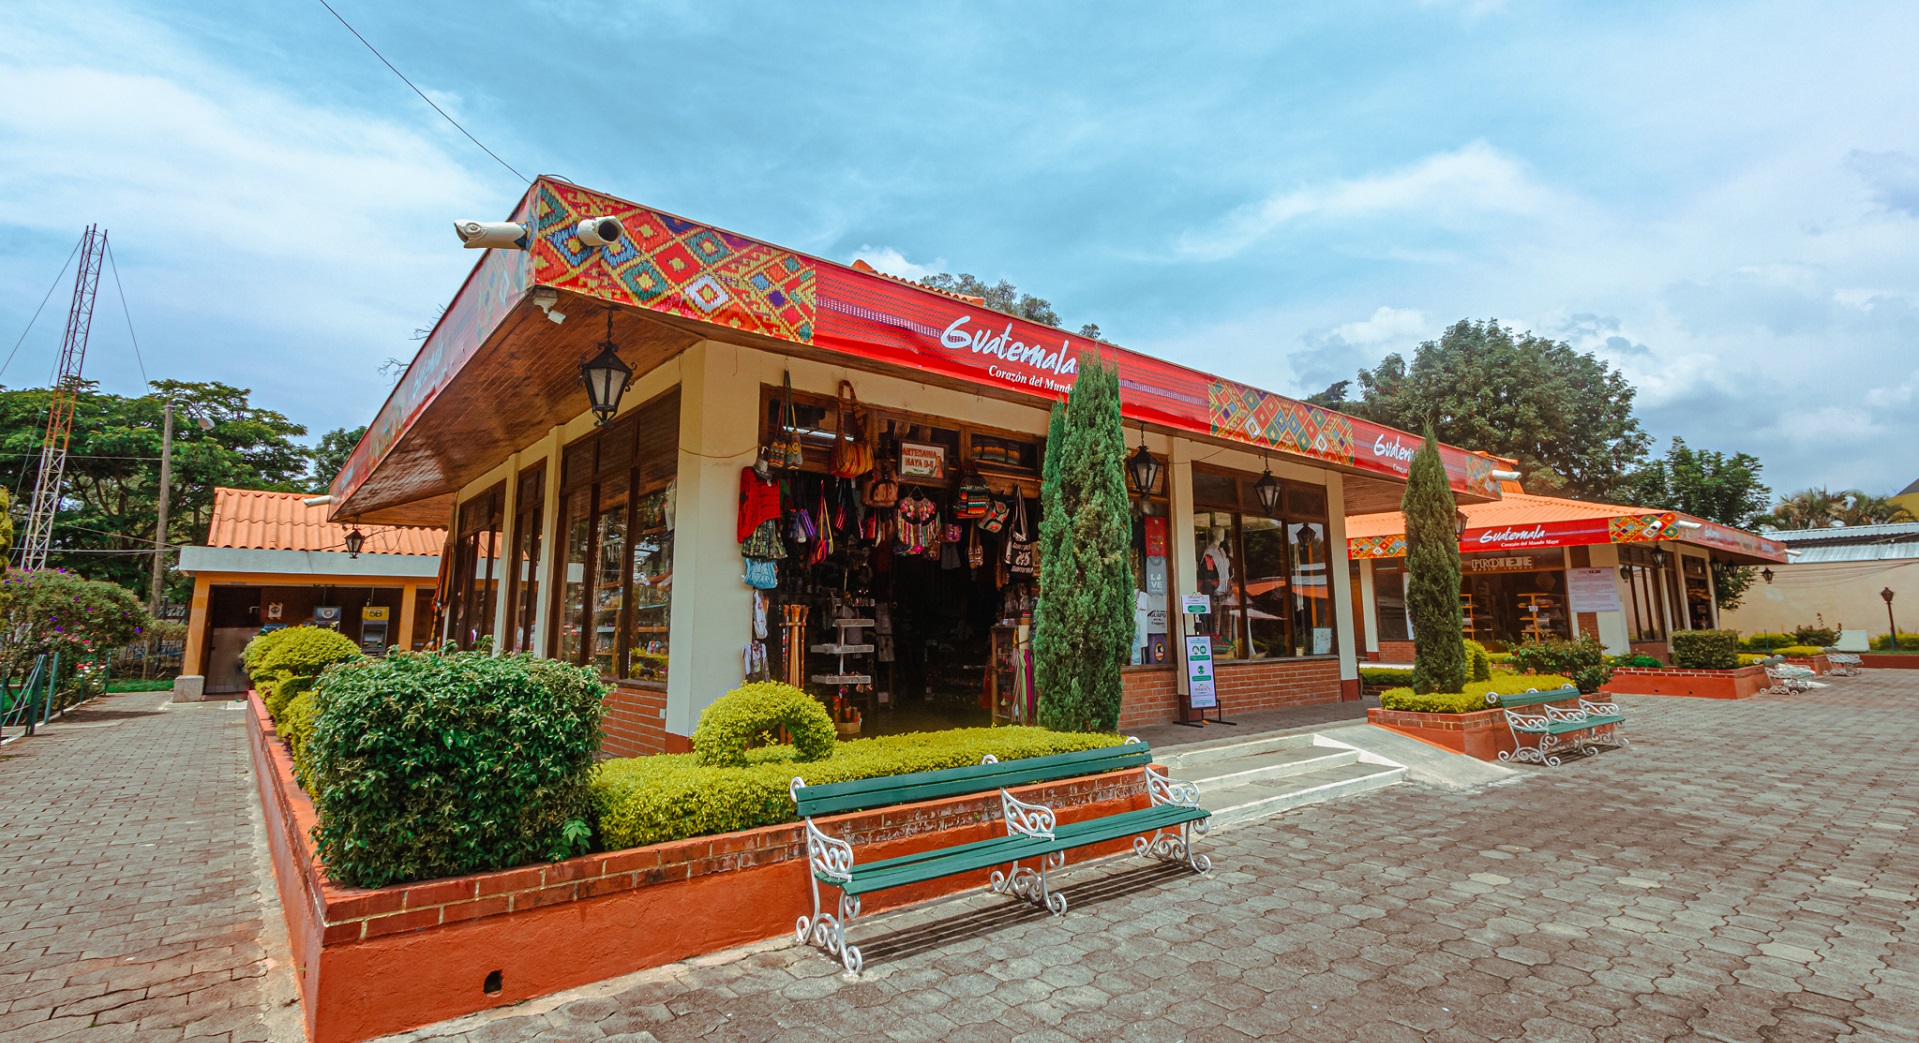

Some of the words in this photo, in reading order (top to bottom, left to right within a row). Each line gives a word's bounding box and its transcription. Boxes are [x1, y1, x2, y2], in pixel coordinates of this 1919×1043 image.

[941, 316, 1077, 375] Guatemala
[988, 365, 1027, 384] Corazón
[1028, 375, 1043, 388] del
[1044, 378, 1073, 393] Mund
[1479, 524, 1546, 543] Guatemala
[369, 609, 383, 617] 5B
